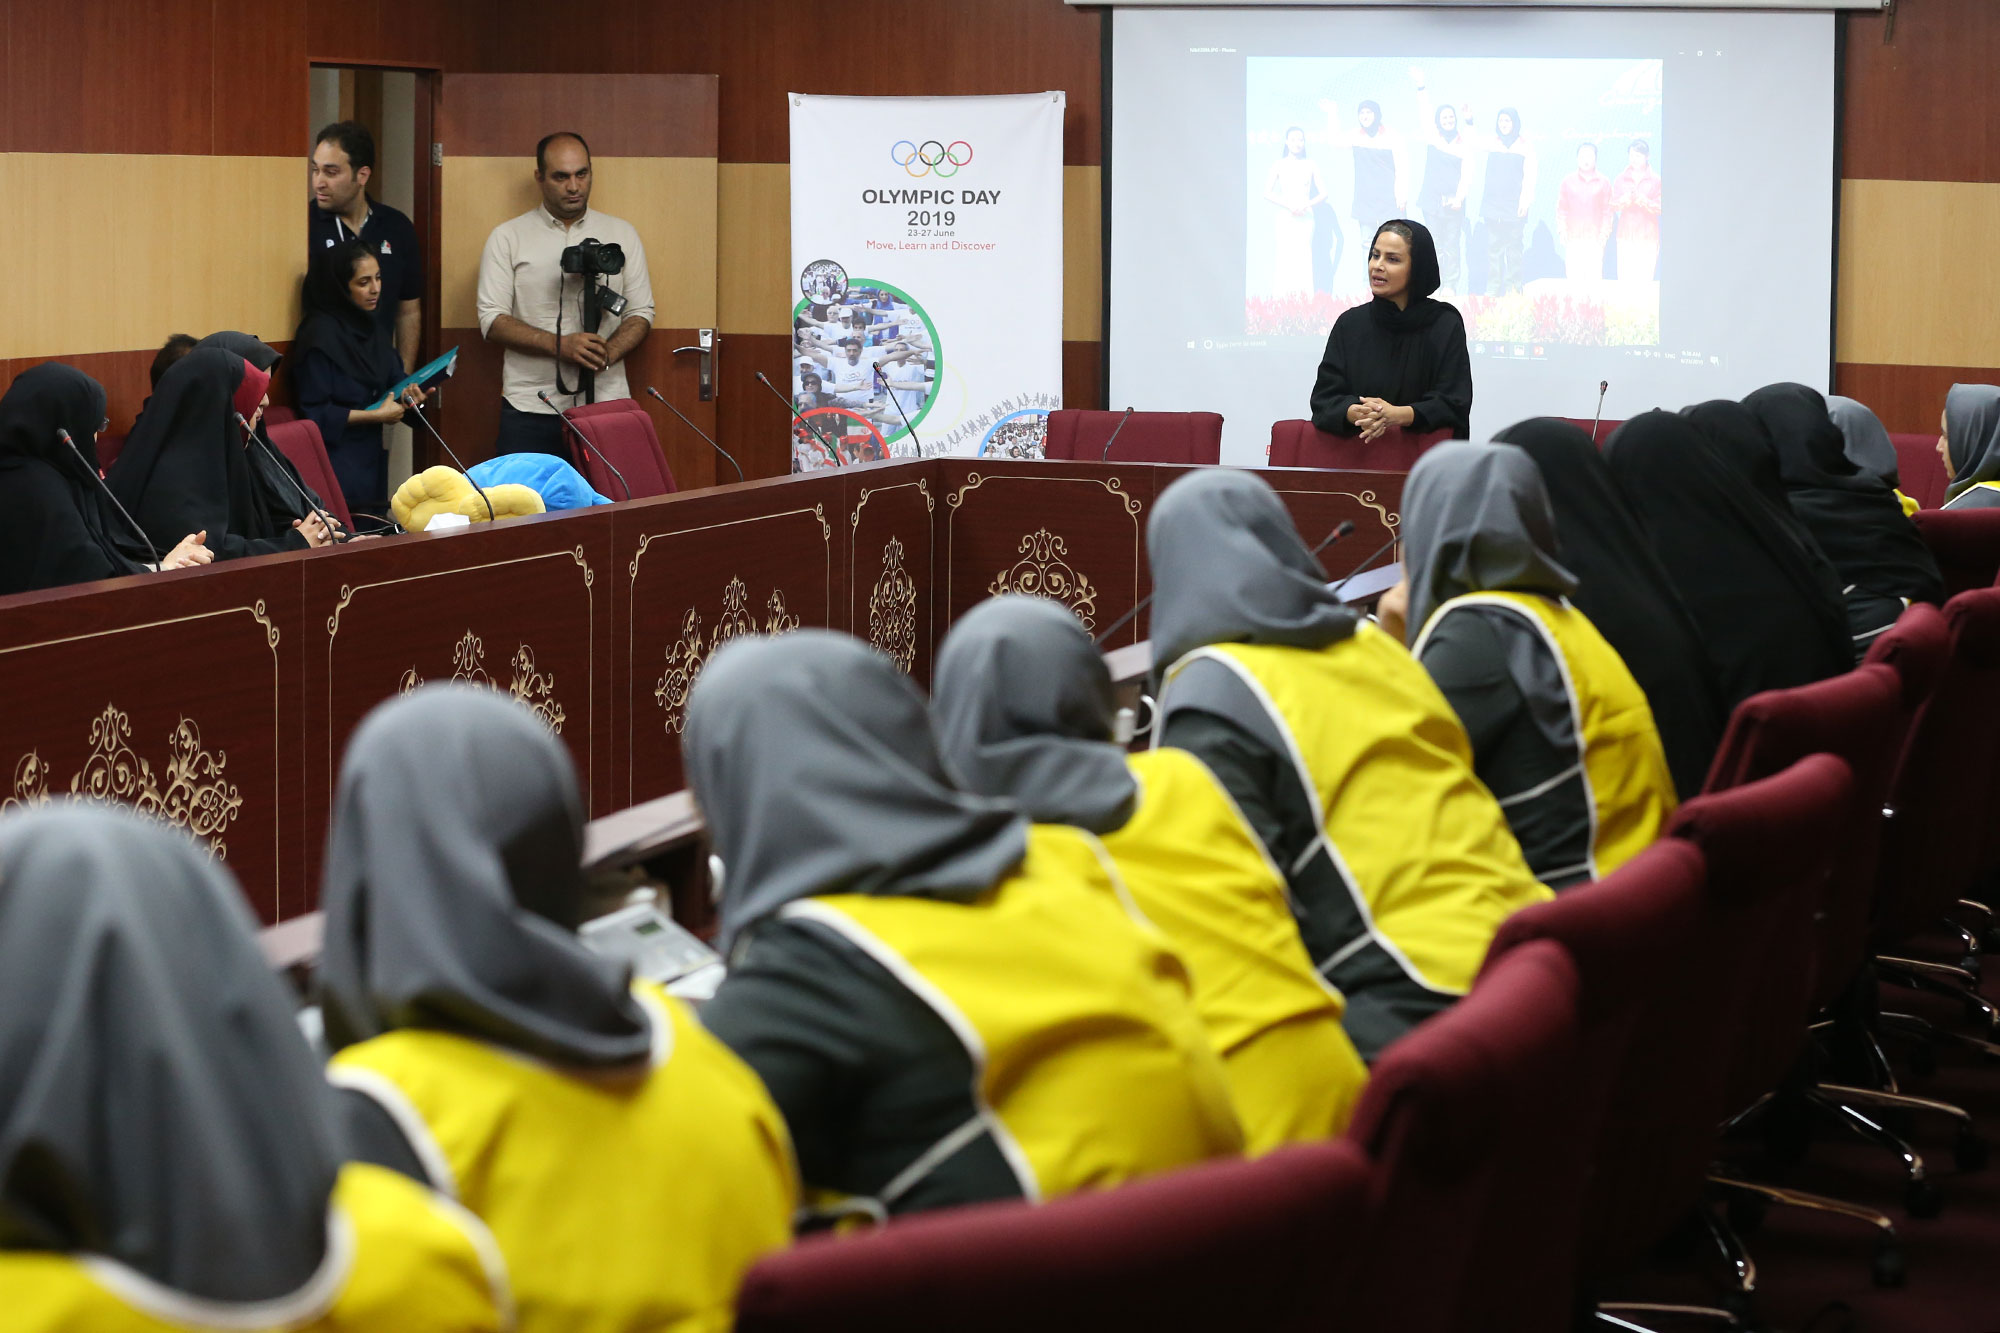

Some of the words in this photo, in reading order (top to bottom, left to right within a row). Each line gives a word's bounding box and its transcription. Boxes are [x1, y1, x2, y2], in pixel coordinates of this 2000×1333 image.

[862, 189, 955, 205] OLYMPIC
[961, 190, 1001, 205] DAY
[907, 210, 956, 227] 2019
[907, 229, 932, 237] 23-27
[933, 229, 955, 237] June
[866, 240, 897, 250] Move,
[898, 240, 927, 250] Learn
[930, 240, 948, 250] and
[951, 241, 996, 251] Discover
